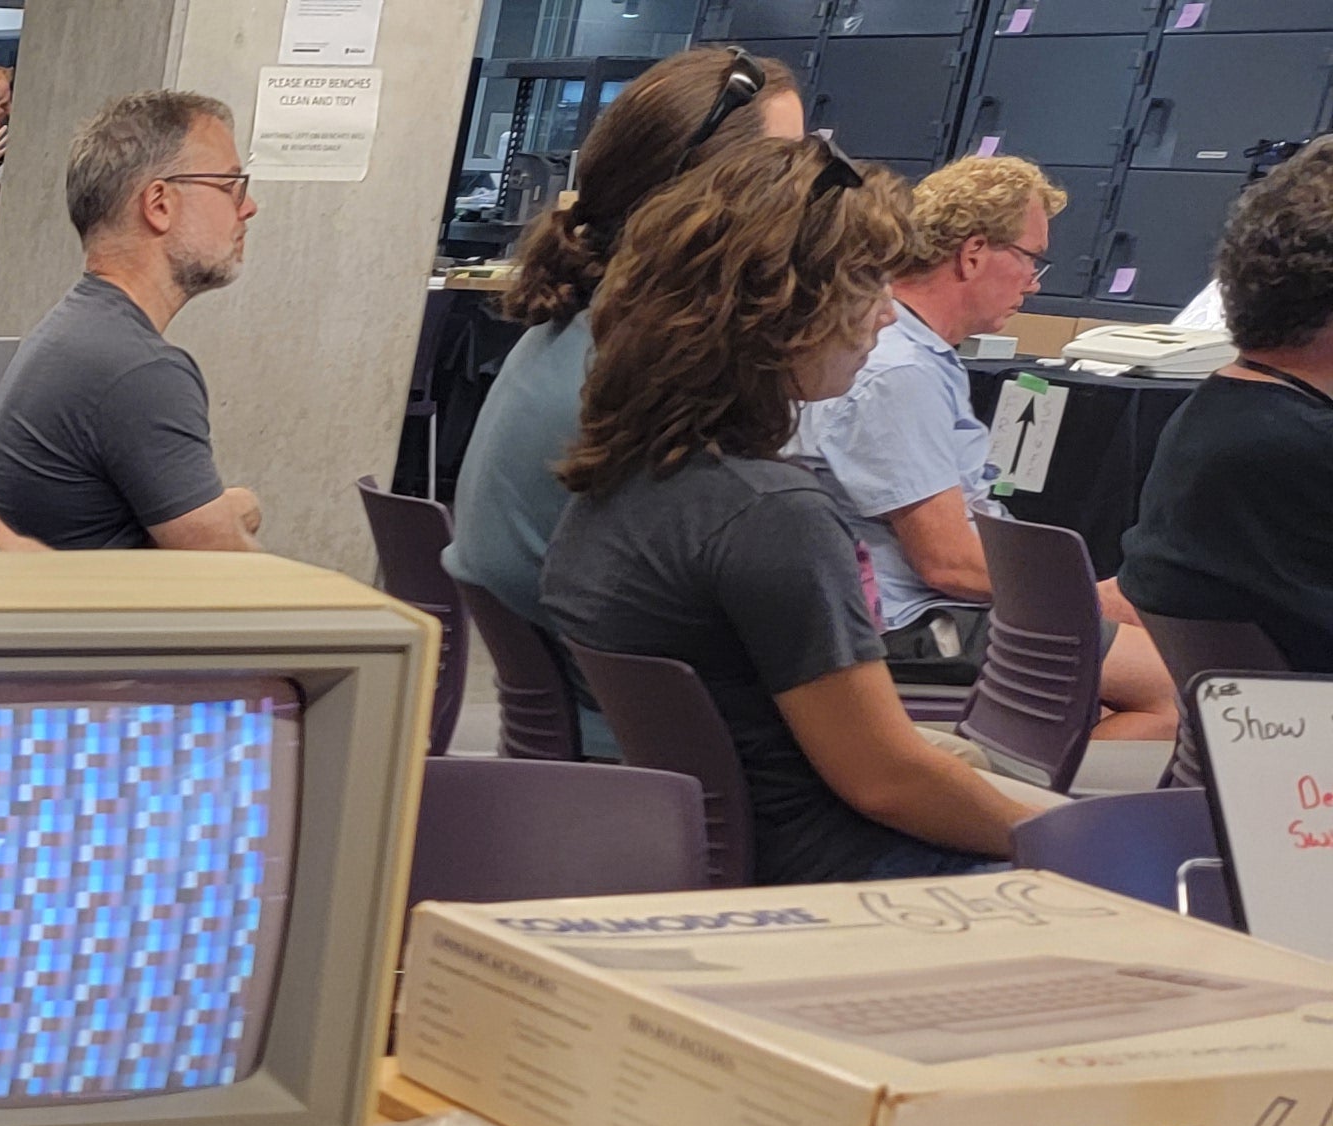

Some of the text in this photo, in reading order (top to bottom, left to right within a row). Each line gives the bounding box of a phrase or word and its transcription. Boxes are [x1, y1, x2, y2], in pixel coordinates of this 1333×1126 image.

[268, 78, 371, 89] PLEASE KEEP BENCHES
[280, 96, 356, 106] CLEAN AND TIDY
[1222, 705, 1306, 743] Show
[495, 906, 830, 934] COMMODORE
